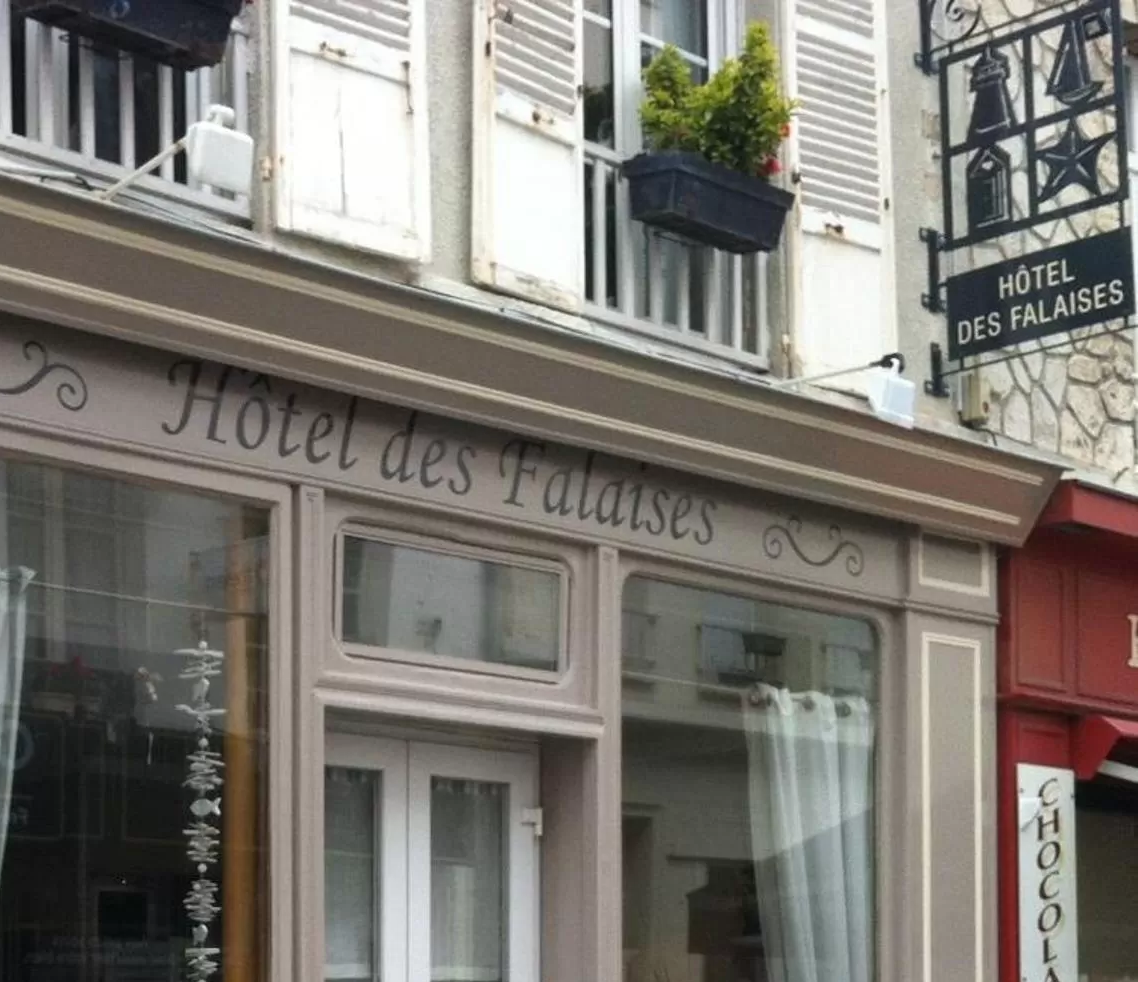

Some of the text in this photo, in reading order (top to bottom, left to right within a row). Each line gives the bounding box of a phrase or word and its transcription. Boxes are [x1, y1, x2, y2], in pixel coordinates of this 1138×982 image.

[998, 257, 1076, 300] HÔTEL
[957, 279, 1124, 346] DES FALAISES
[161, 358, 719, 546] Hôtel des Falaises
